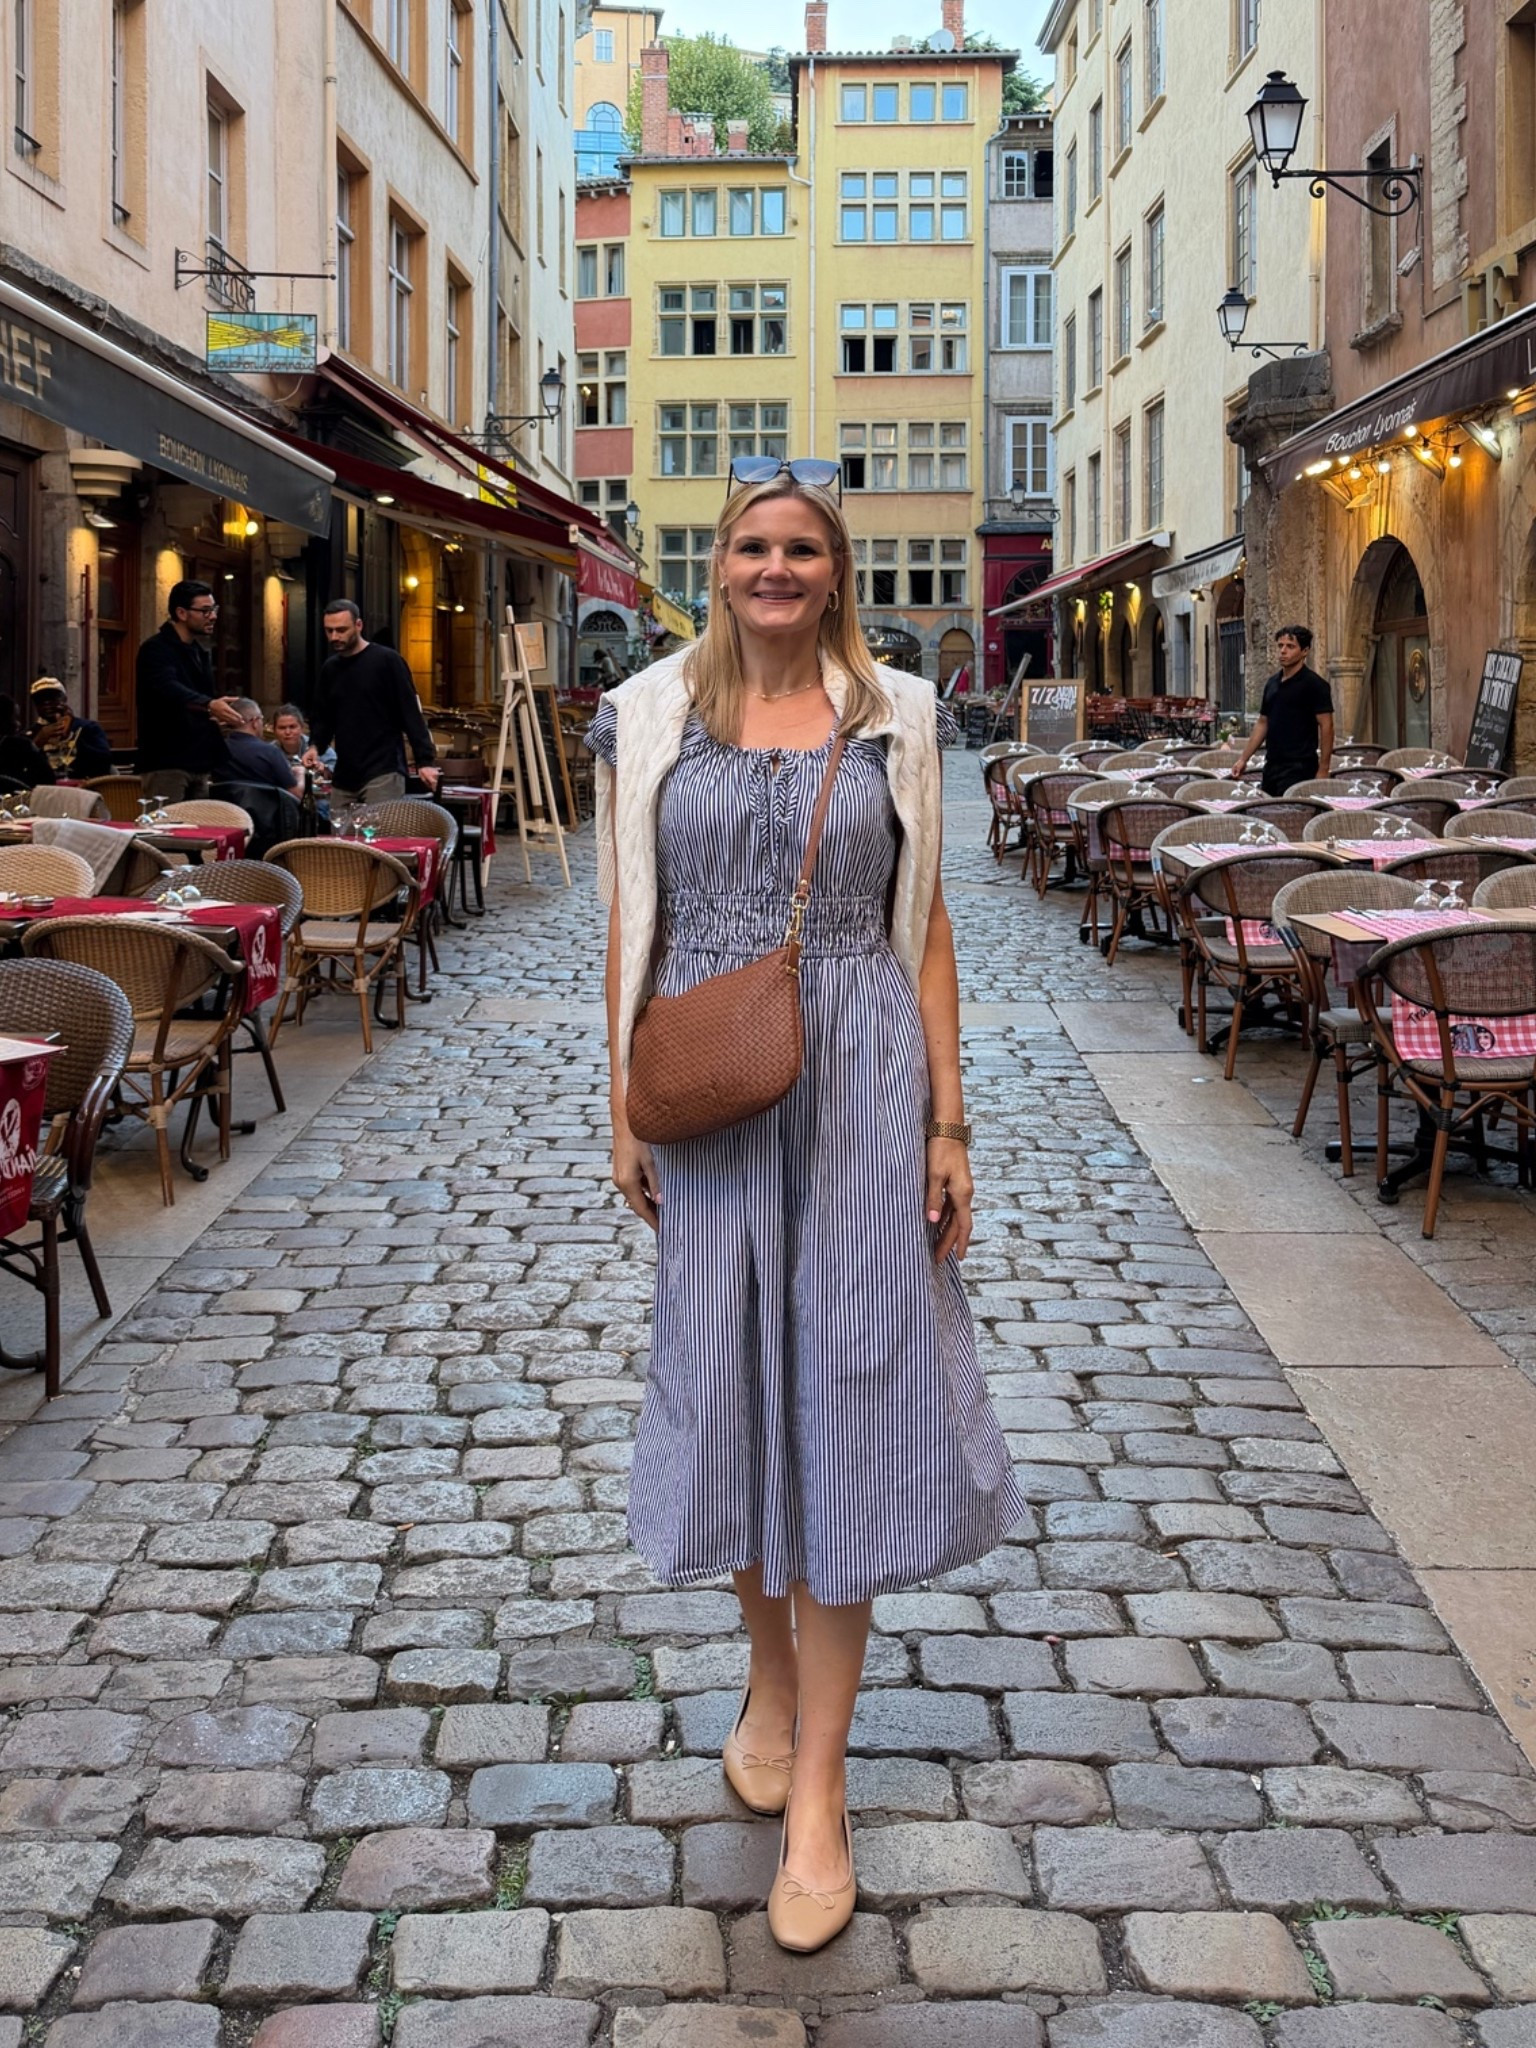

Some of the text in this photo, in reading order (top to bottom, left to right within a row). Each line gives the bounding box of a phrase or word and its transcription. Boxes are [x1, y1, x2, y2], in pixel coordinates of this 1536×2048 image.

[159, 433, 249, 495] BOUCHON LYONNAIS
[1031, 686, 1056, 705] 7/7
